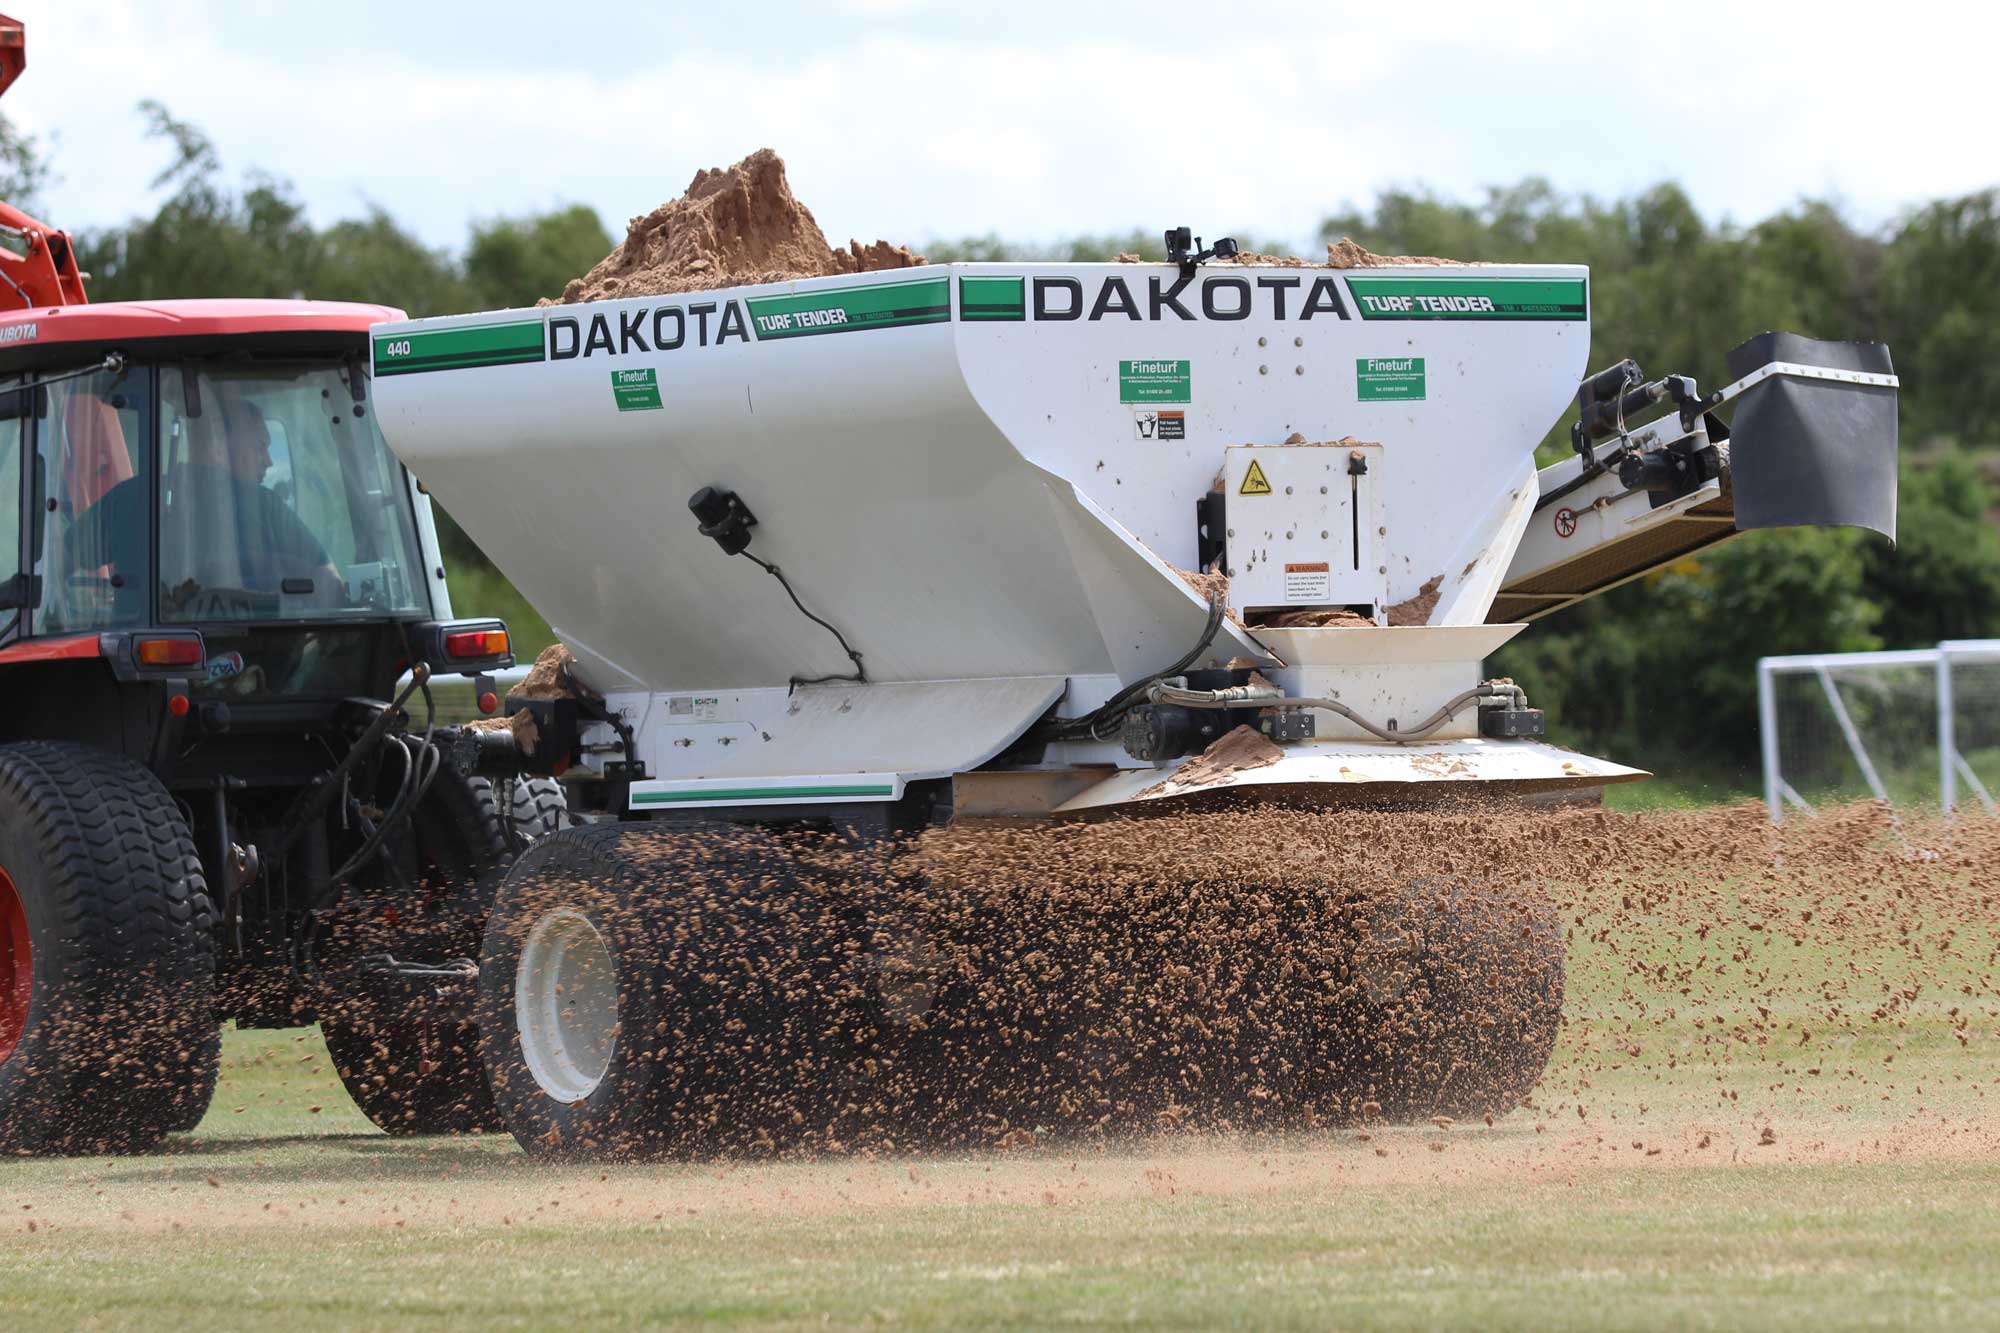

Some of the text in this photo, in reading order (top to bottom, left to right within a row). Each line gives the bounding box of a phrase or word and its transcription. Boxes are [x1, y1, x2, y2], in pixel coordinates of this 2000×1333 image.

[1033, 275, 1352, 321] DAKOTA
[1362, 296, 1414, 312] TURF
[1415, 296, 1496, 312] TENDER
[757, 313, 792, 332] TURF
[792, 308, 849, 329] TENDER
[0, 323, 37, 343] UBOTA
[549, 299, 750, 361] DAKOTA
[387, 340, 411, 357] 440
[1131, 361, 1178, 374] Fineturf
[1367, 358, 1413, 371] Fineturf
[618, 369, 648, 383] Fineturf
